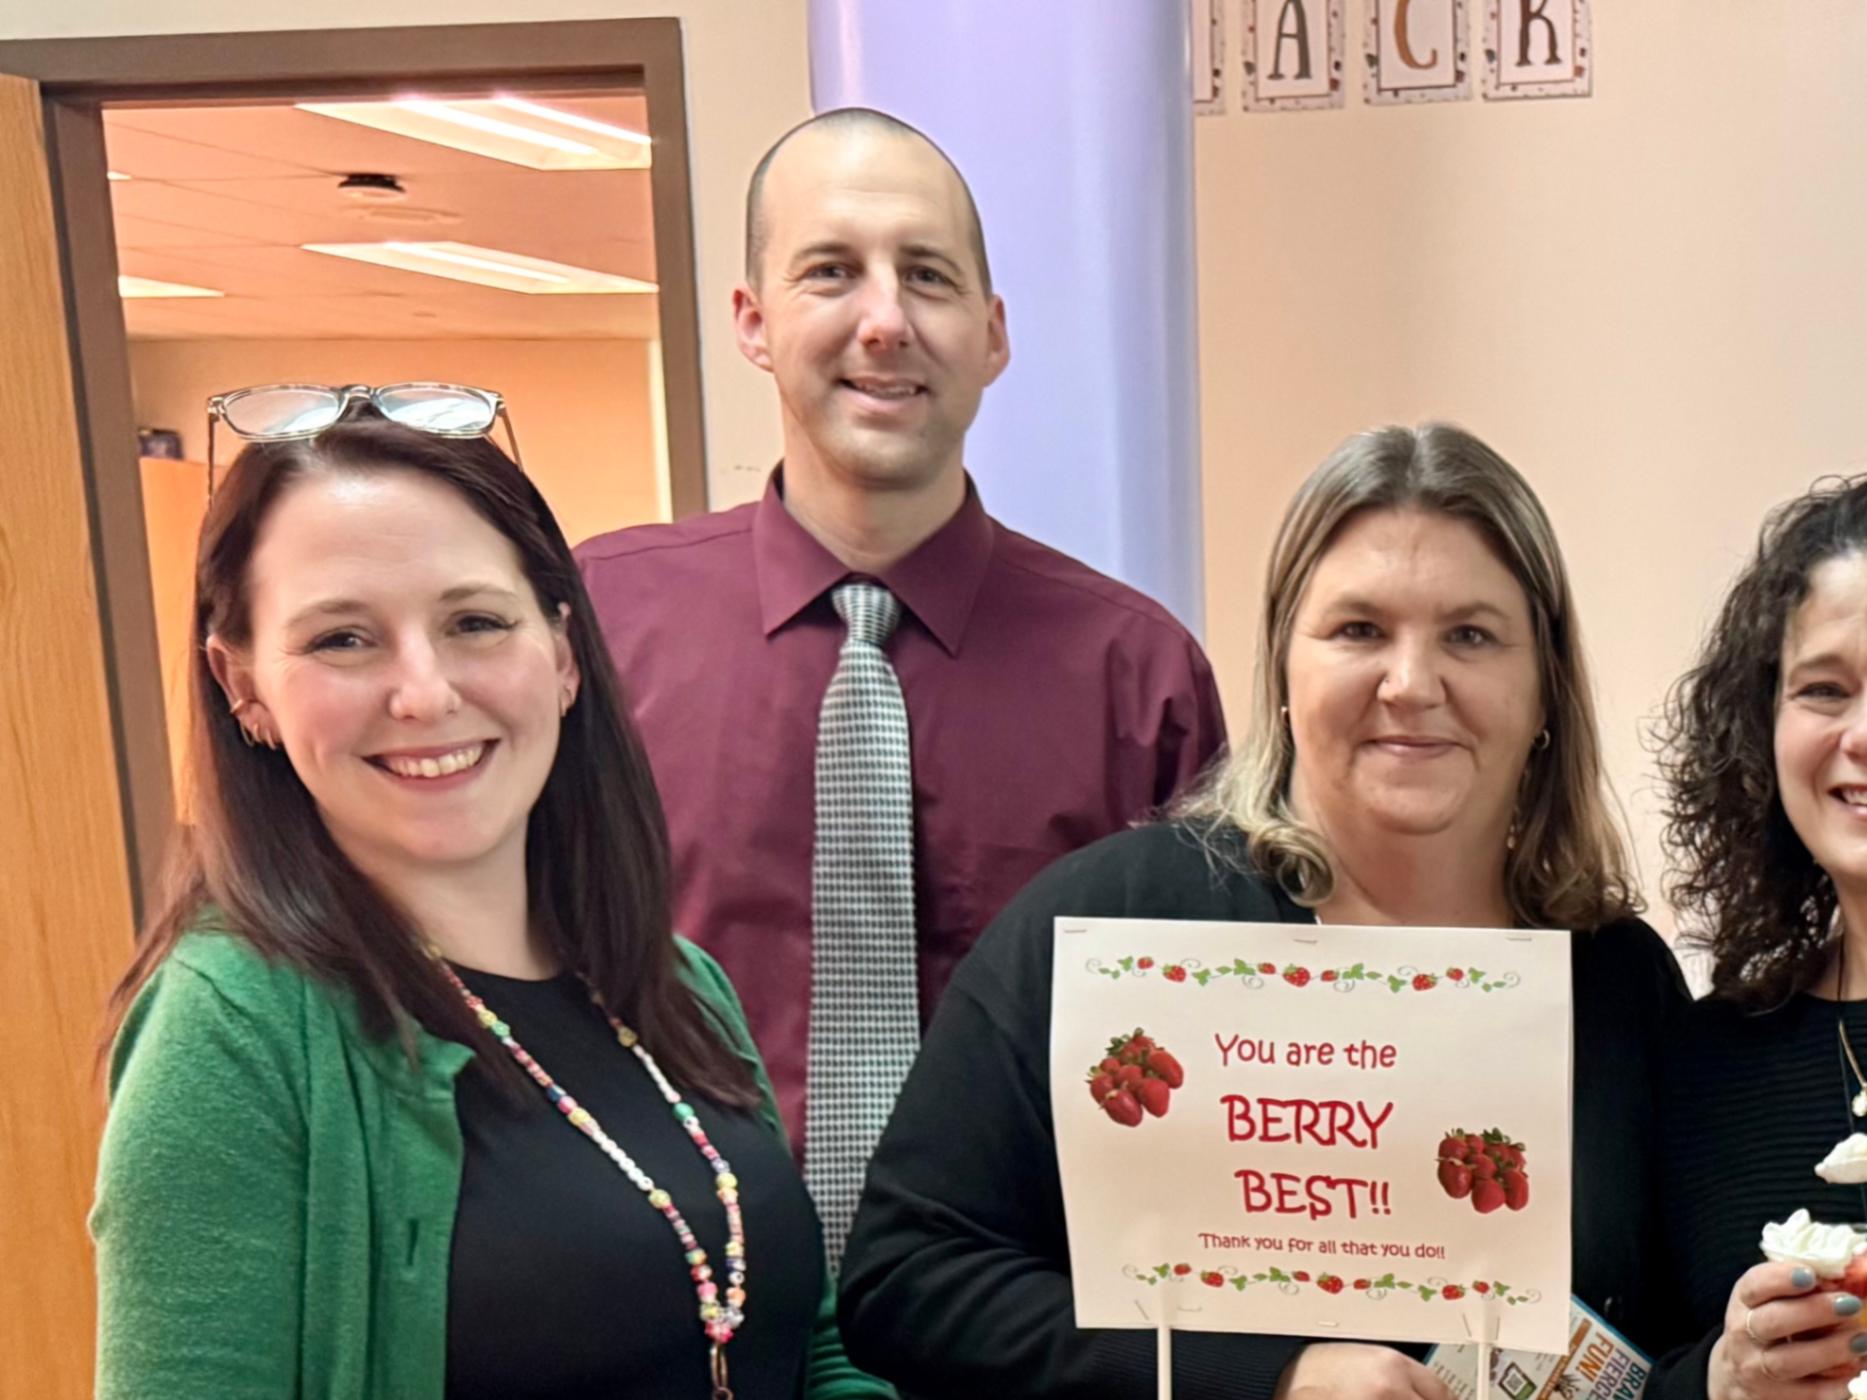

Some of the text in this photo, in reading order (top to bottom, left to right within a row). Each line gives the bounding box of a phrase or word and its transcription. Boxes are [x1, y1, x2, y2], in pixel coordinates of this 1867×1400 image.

[1214, 1033, 1397, 1069] You are the
[1220, 1094, 1394, 1149] BERRY
[1234, 1168, 1392, 1220] BEST!!
[1198, 1233, 1446, 1260] Thank you for all that you do!!
[1574, 1331, 1616, 1383] FUN!
